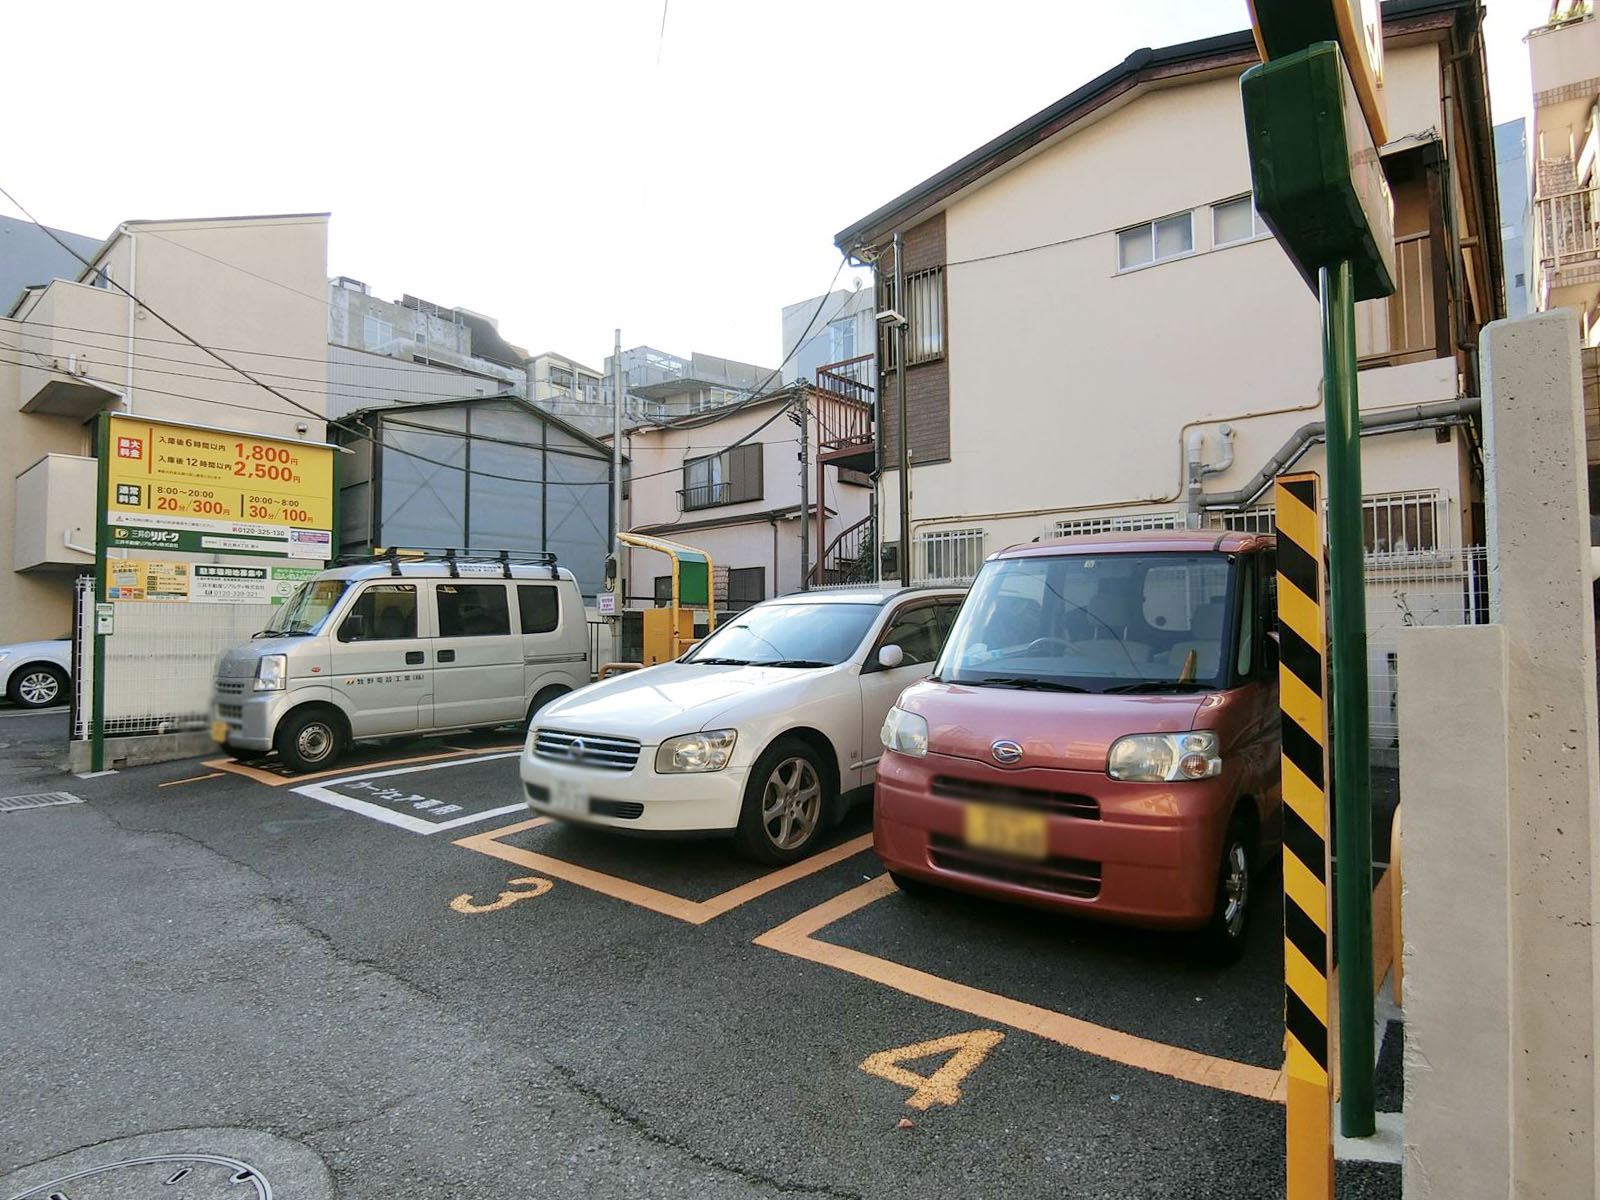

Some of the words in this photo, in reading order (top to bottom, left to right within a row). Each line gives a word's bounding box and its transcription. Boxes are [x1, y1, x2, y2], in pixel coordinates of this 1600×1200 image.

[120, 438, 141, 449] 最大
[120, 448, 140, 458] 料金
[159, 436, 226, 452] 入庫後6時間以内
[235, 442, 298, 466] 1,800円
[158, 455, 232, 471] 入庫後12時間以内
[233, 461, 301, 484] 2,500円
[118, 494, 139, 505] 料金
[119, 485, 139, 495] 通常
[131, 529, 180, 542] 三井のリパーク
[344, 780, 465, 816] カーシェア専用
[450, 876, 554, 914] 3
[858, 1029, 1006, 1111] 4
